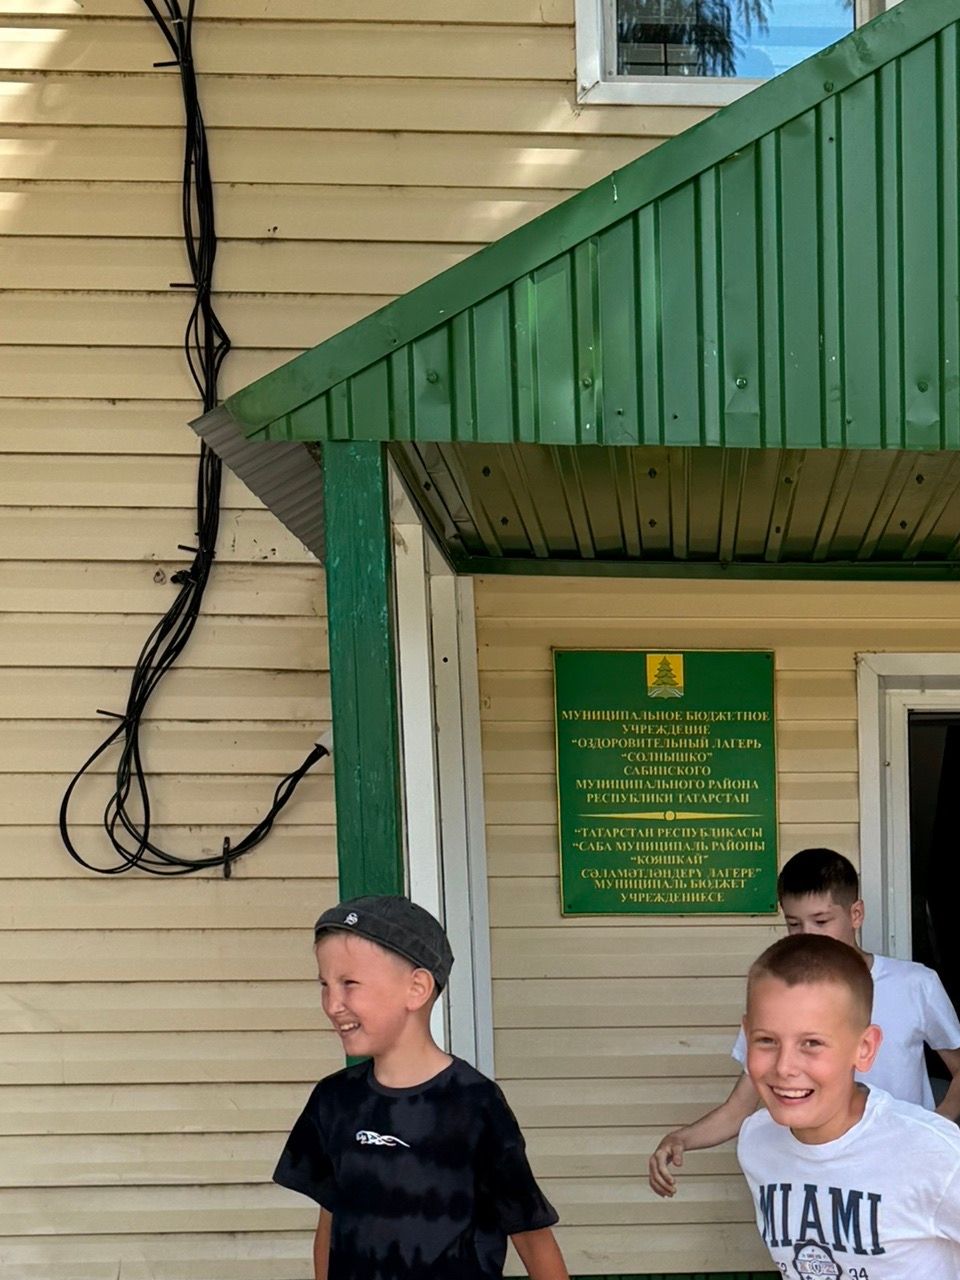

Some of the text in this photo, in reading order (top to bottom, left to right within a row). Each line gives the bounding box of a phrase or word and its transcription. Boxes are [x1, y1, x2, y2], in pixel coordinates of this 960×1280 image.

[562, 710, 770, 721] МУНИЦИПАЛЬНОЕ БЮДЖЕТНОЕ
[622, 725, 711, 735] УЧРЕЖДЕНИЕ
[712, 739, 762, 749] ЛАГЕРЬ
[623, 766, 712, 776] САБИНСКОГО
[576, 778, 759, 790] МУНИЦИПАЛЬНОГО РАЙОНА
[587, 793, 749, 803] РЕСПУБЛИКИ ТАТАРСТАН
[657, 828, 763, 838] РЕСПУБЛИКАСЫ
[615, 841, 709, 852] МУНИЦИПАЛЬ
[711, 839, 765, 851] РАЙОНЫ
[594, 879, 747, 890] МУНИЦИПАЛЬ БЮДЖЕТ
[759, 1183, 886, 1255] MIAMI
